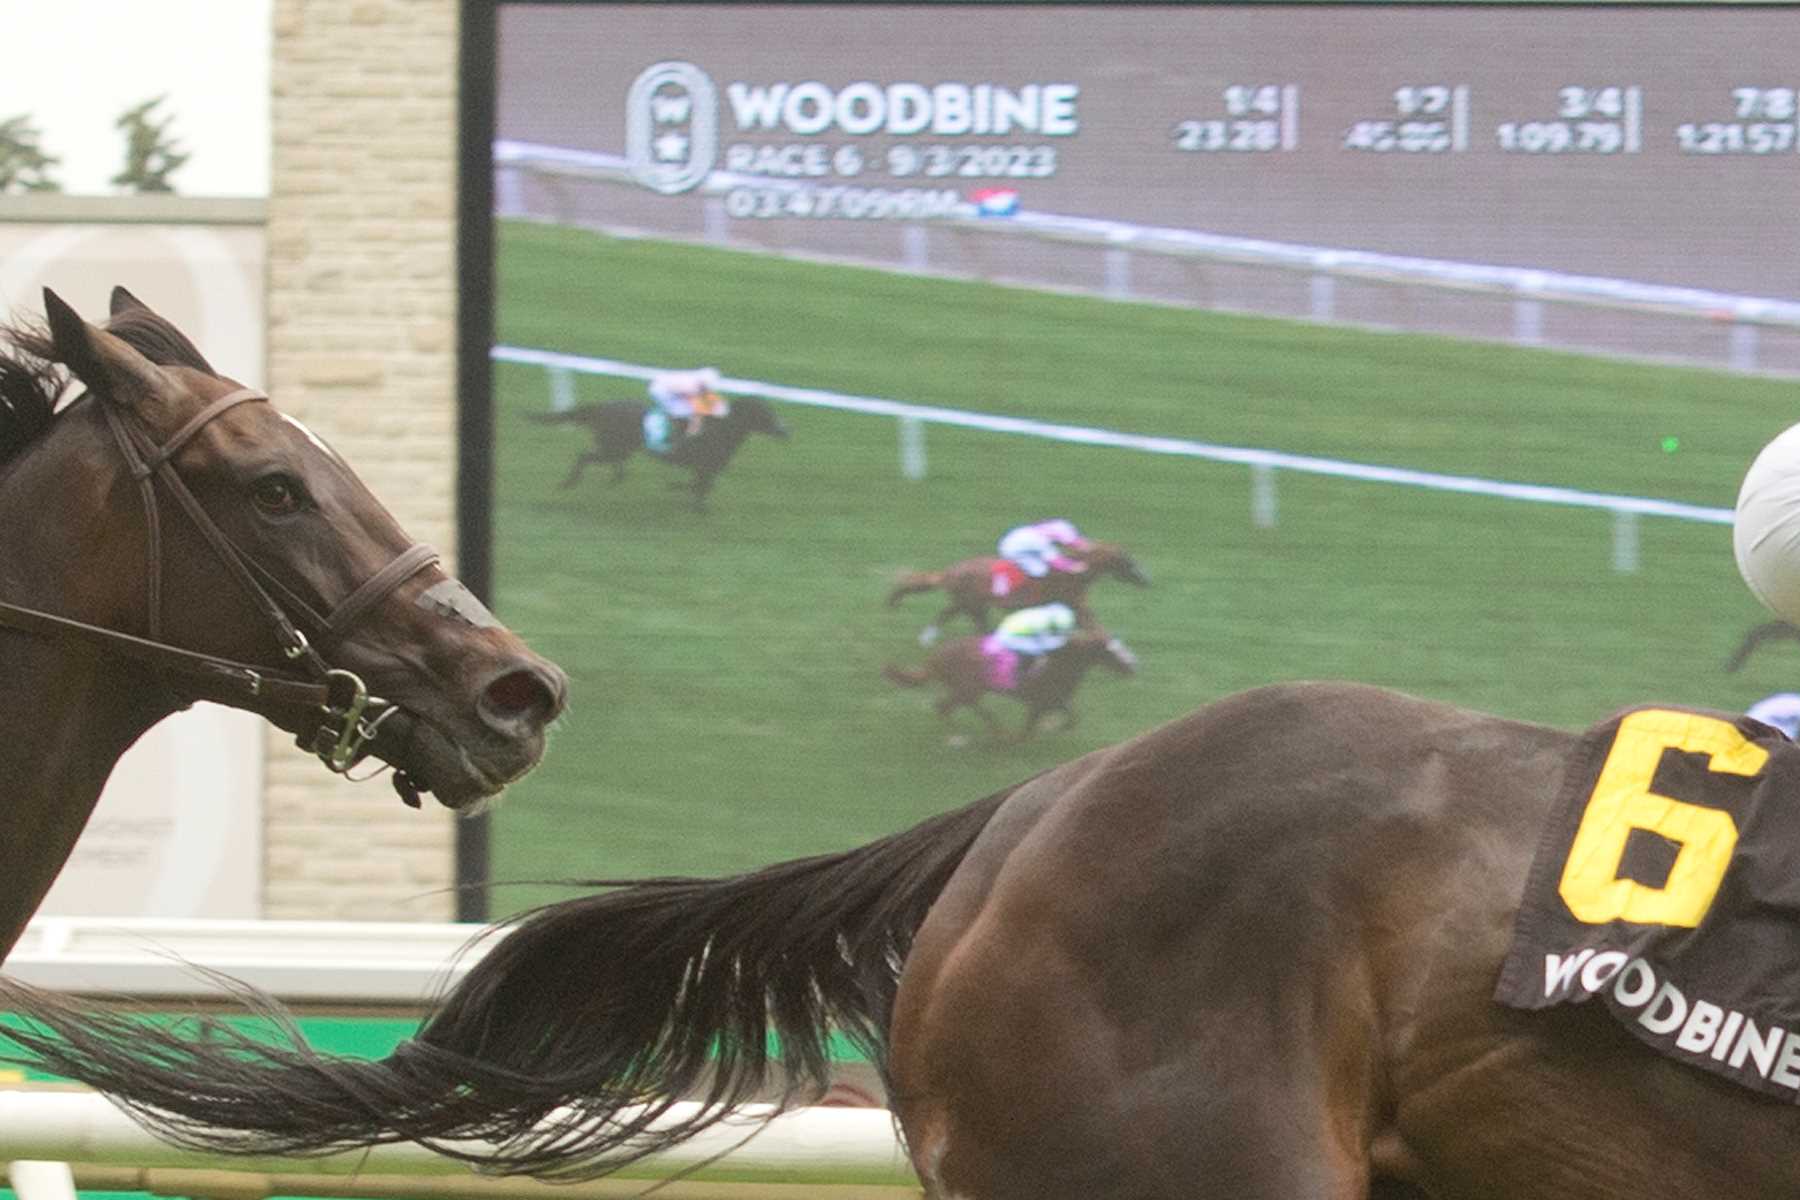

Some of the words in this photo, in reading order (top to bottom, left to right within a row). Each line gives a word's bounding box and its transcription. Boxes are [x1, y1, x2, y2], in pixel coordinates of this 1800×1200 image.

[727, 81, 1080, 136] WOODBINE
[727, 144, 829, 176] RACE
[834, 144, 863, 176] 6
[1558, 708, 1769, 928] 6
